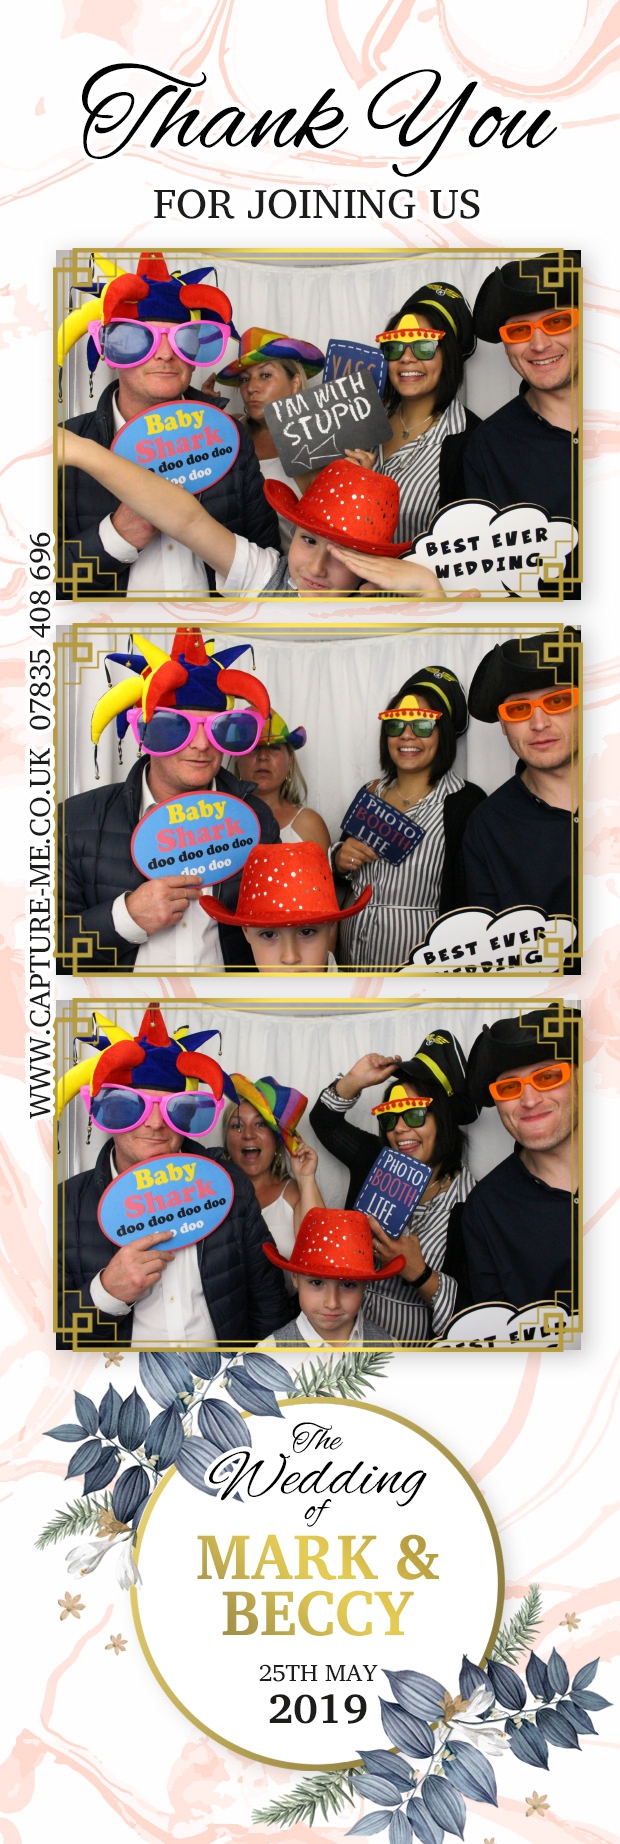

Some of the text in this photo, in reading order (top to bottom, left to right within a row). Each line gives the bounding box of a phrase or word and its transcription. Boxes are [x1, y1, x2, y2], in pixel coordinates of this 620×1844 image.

[144, 409, 205, 435] Baby
[272, 393, 310, 422] I'M
[135, 425, 224, 464] Shark
[158, 459, 184, 474] doo
[186, 452, 209, 466] doo
[212, 446, 233, 459] doo
[166, 467, 212, 485] oo doo
[426, 527, 548, 557] BEST EVER
[435, 552, 543, 578] WEDDING
[166, 799, 227, 825] Baby
[366, 798, 416, 839] PHOTO
[156, 817, 244, 853] Shark
[355, 806, 411, 851] BOOTH
[357, 825, 391, 855] LIFE
[147, 837, 254, 870] doo doo doo doo
[208, 858, 232, 871] doo
[423, 926, 546, 965] BEST EVER
[132, 1162, 197, 1190] Baby
[382, 1153, 424, 1186] PHOTO
[124, 1178, 217, 1219] Shark
[371, 1168, 418, 1208] BOOTH
[116, 1222, 145, 1237] doo
[148, 1213, 174, 1228] doo
[177, 1205, 201, 1218] doo
[204, 1197, 226, 1210] doo
[366, 1192, 397, 1226] LIFE
[180, 1220, 204, 1234] doo
